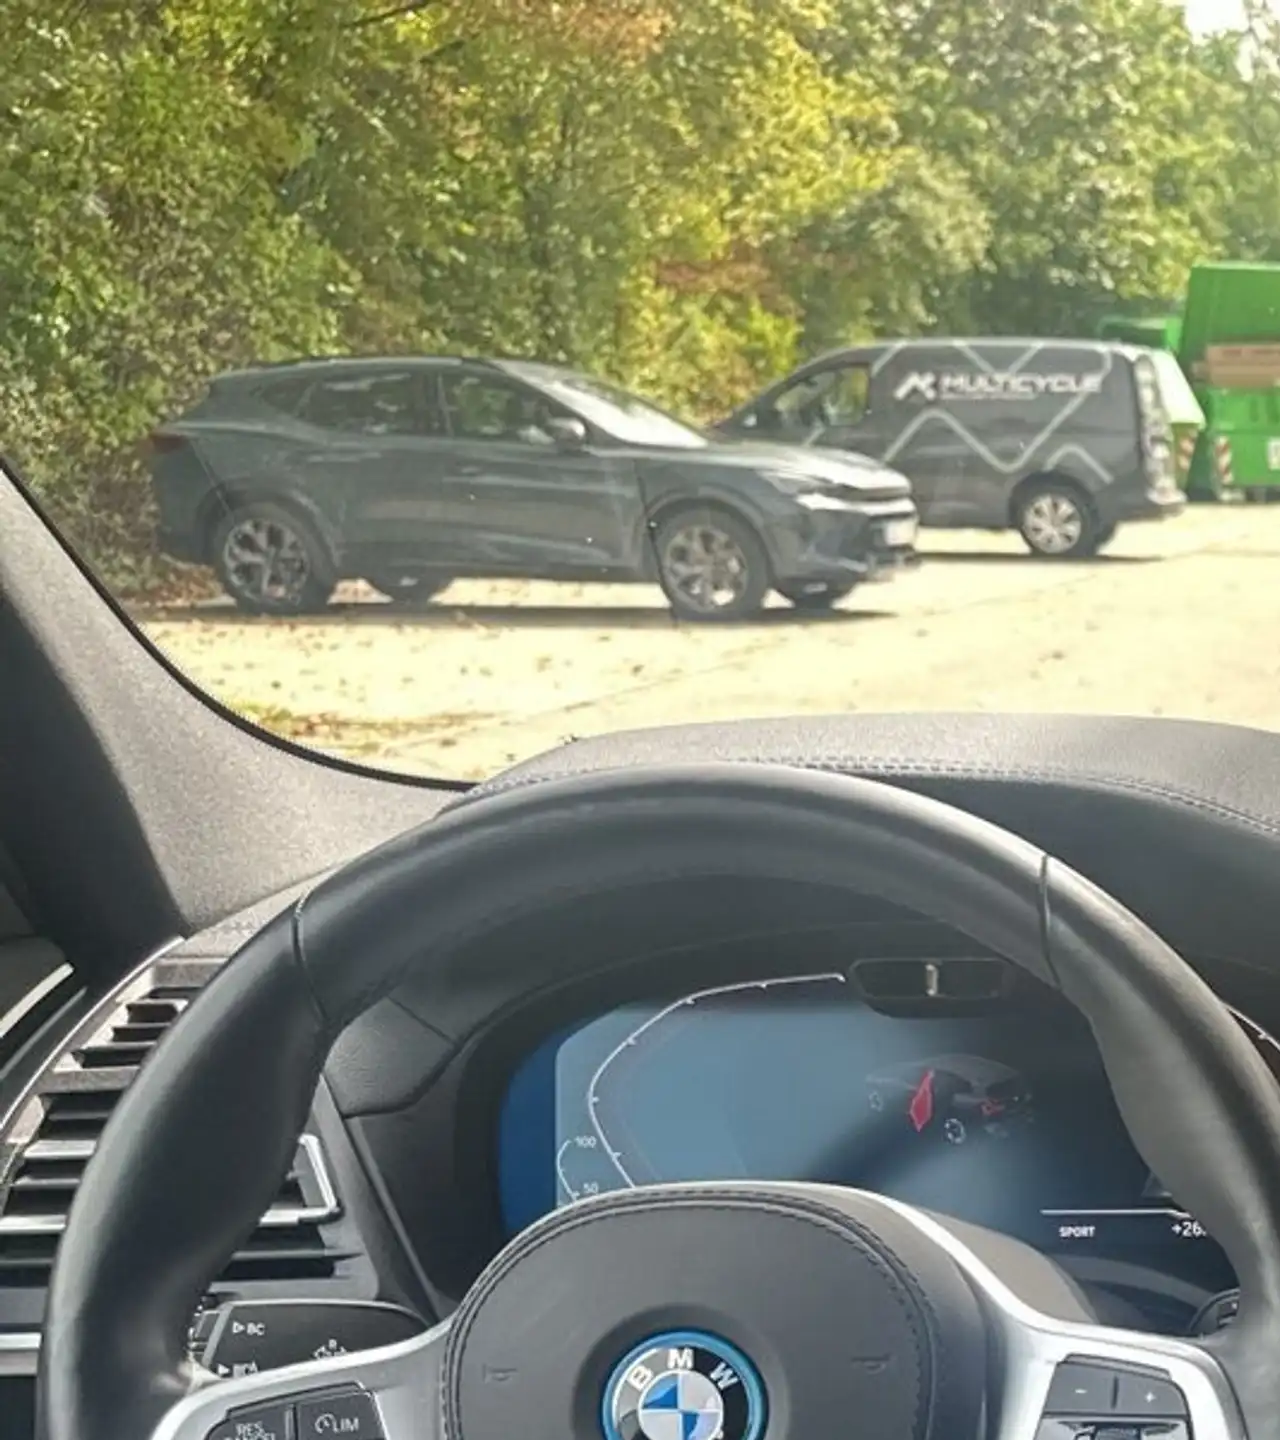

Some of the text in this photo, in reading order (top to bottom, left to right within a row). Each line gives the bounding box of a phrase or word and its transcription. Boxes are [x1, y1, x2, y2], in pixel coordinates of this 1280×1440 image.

[939, 372, 1101, 393] MULTICYCLE
[1059, 1226, 1095, 1238] SPORT
[626, 1347, 738, 1390] BMW
[235, 1421, 264, 1436] RES
